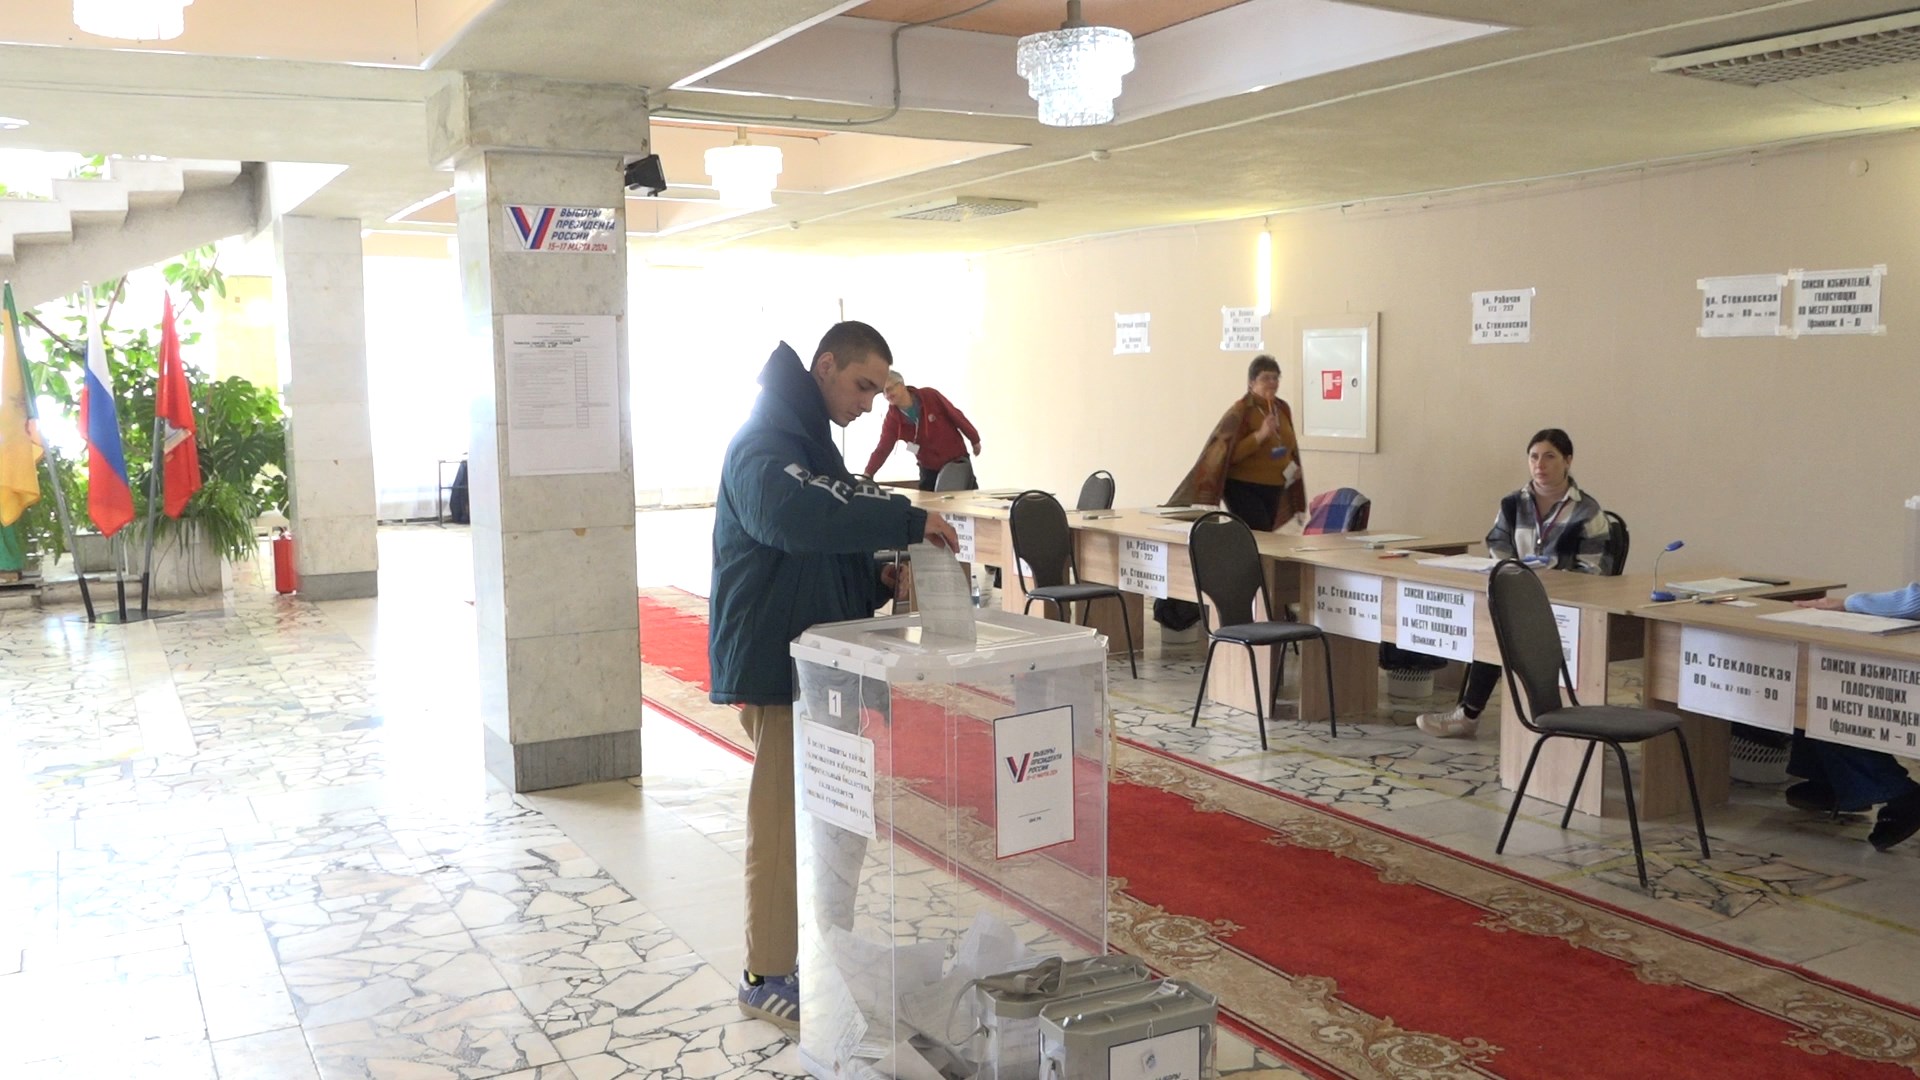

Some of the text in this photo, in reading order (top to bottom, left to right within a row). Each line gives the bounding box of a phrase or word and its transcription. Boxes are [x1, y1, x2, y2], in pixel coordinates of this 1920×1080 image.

[560, 208, 602, 218] ВЫБОРЫ
[556, 220, 615, 230] ПРЕЗИДЕНТА
[552, 232, 590, 240] РОССИИ
[1722, 294, 1778, 304] Стекловская
[1331, 586, 1378, 603] Стекловская
[1404, 587, 1424, 600] СПИСОК
[1684, 651, 1792, 682] ул. Стекловская
[1821, 657, 1856, 675] СПИСОК
[1694, 673, 1706, 686] 80
[1764, 687, 1778, 700] 90
[1841, 680, 1907, 704] ГОЛОСУЮЩИХ
[832, 694, 837, 712] 1
[1816, 696, 1828, 710] ПО
[1832, 698, 1863, 716] МЕСТУ
[1880, 727, 1890, 742] М
[1906, 732, 1916, 747] Я)
